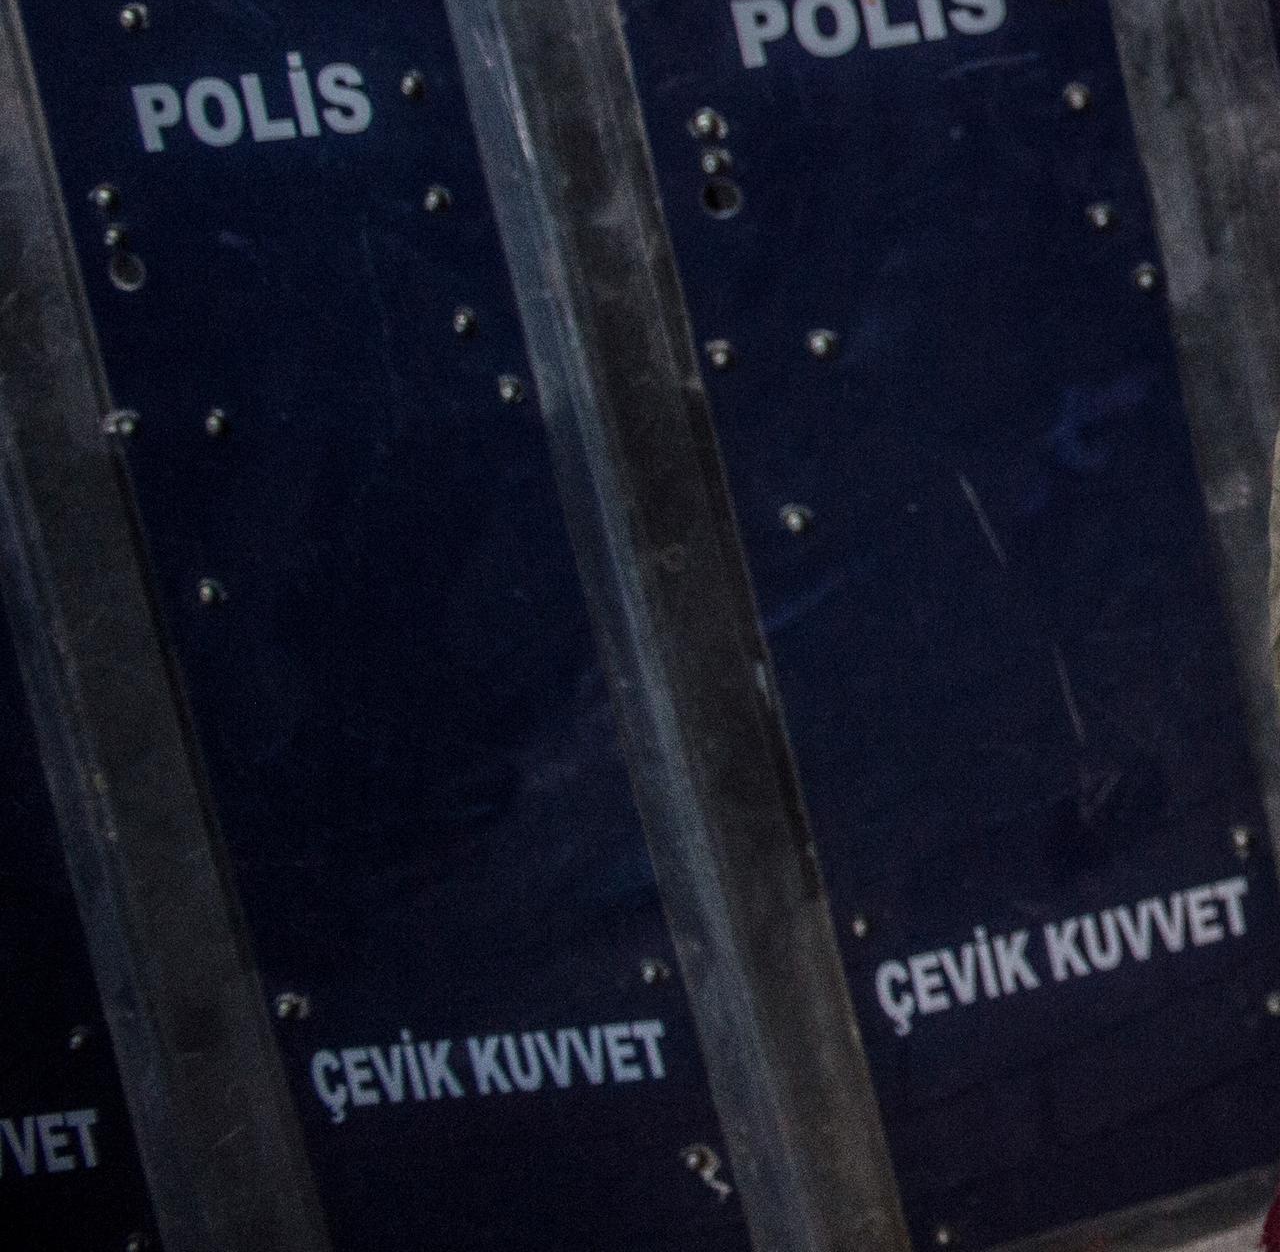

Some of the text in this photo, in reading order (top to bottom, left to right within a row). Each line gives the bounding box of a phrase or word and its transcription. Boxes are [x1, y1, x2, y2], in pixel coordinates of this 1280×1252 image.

[132, 51, 373, 152] POLİS
[875, 876, 1249, 1036] ÇEVİK KUVVET
[311, 1018, 666, 1125] ÇEVİK KUVVET
